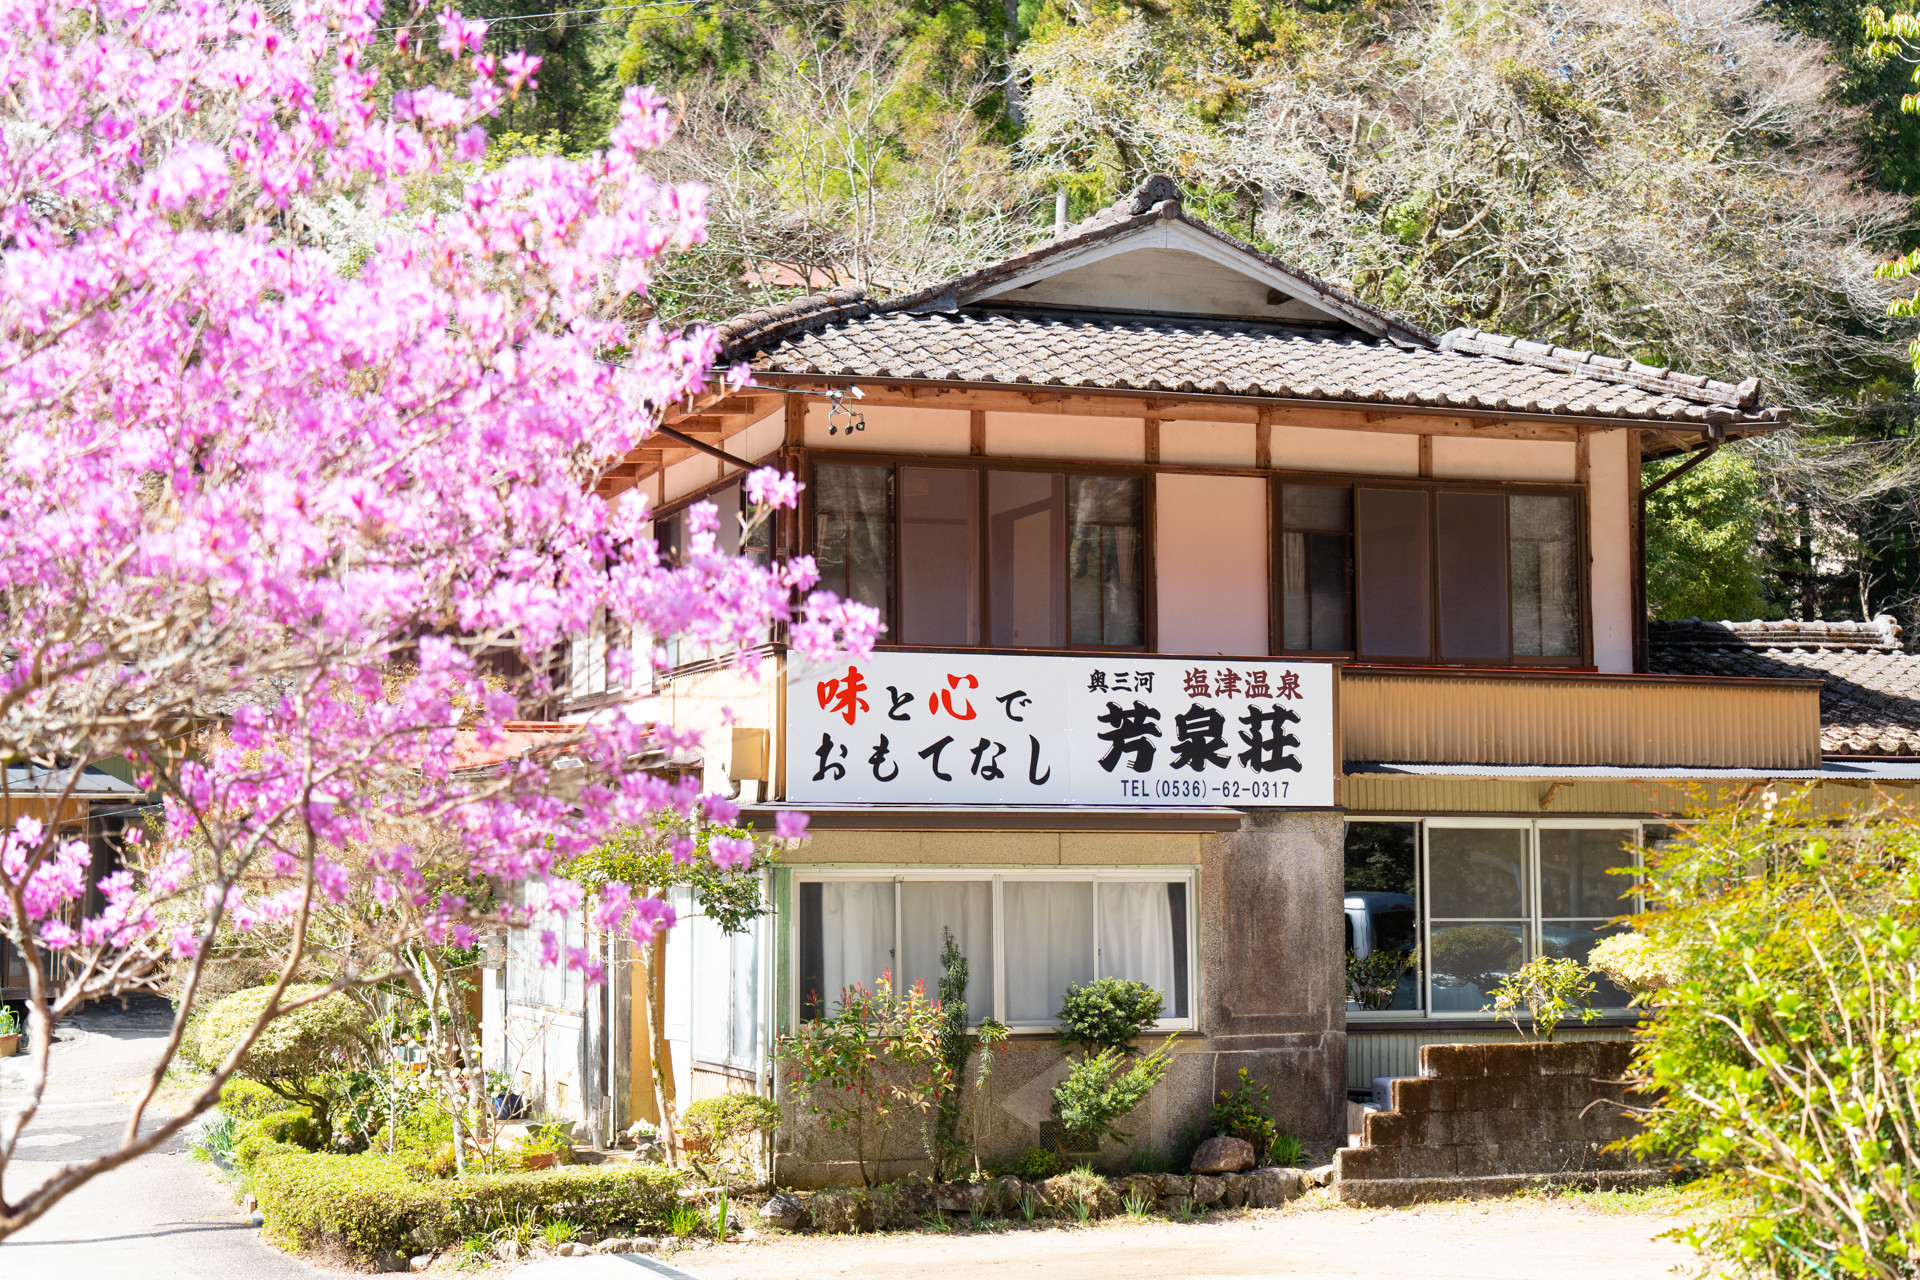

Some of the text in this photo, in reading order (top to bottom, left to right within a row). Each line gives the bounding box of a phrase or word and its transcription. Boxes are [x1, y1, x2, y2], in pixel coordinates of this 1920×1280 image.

[816, 665, 1033, 726] 味と心で
[1087, 667, 1304, 700] 奥三河 塩津温泉
[811, 732, 1051, 786] おもてなし
[1097, 699, 1303, 774] 芳泉荘
